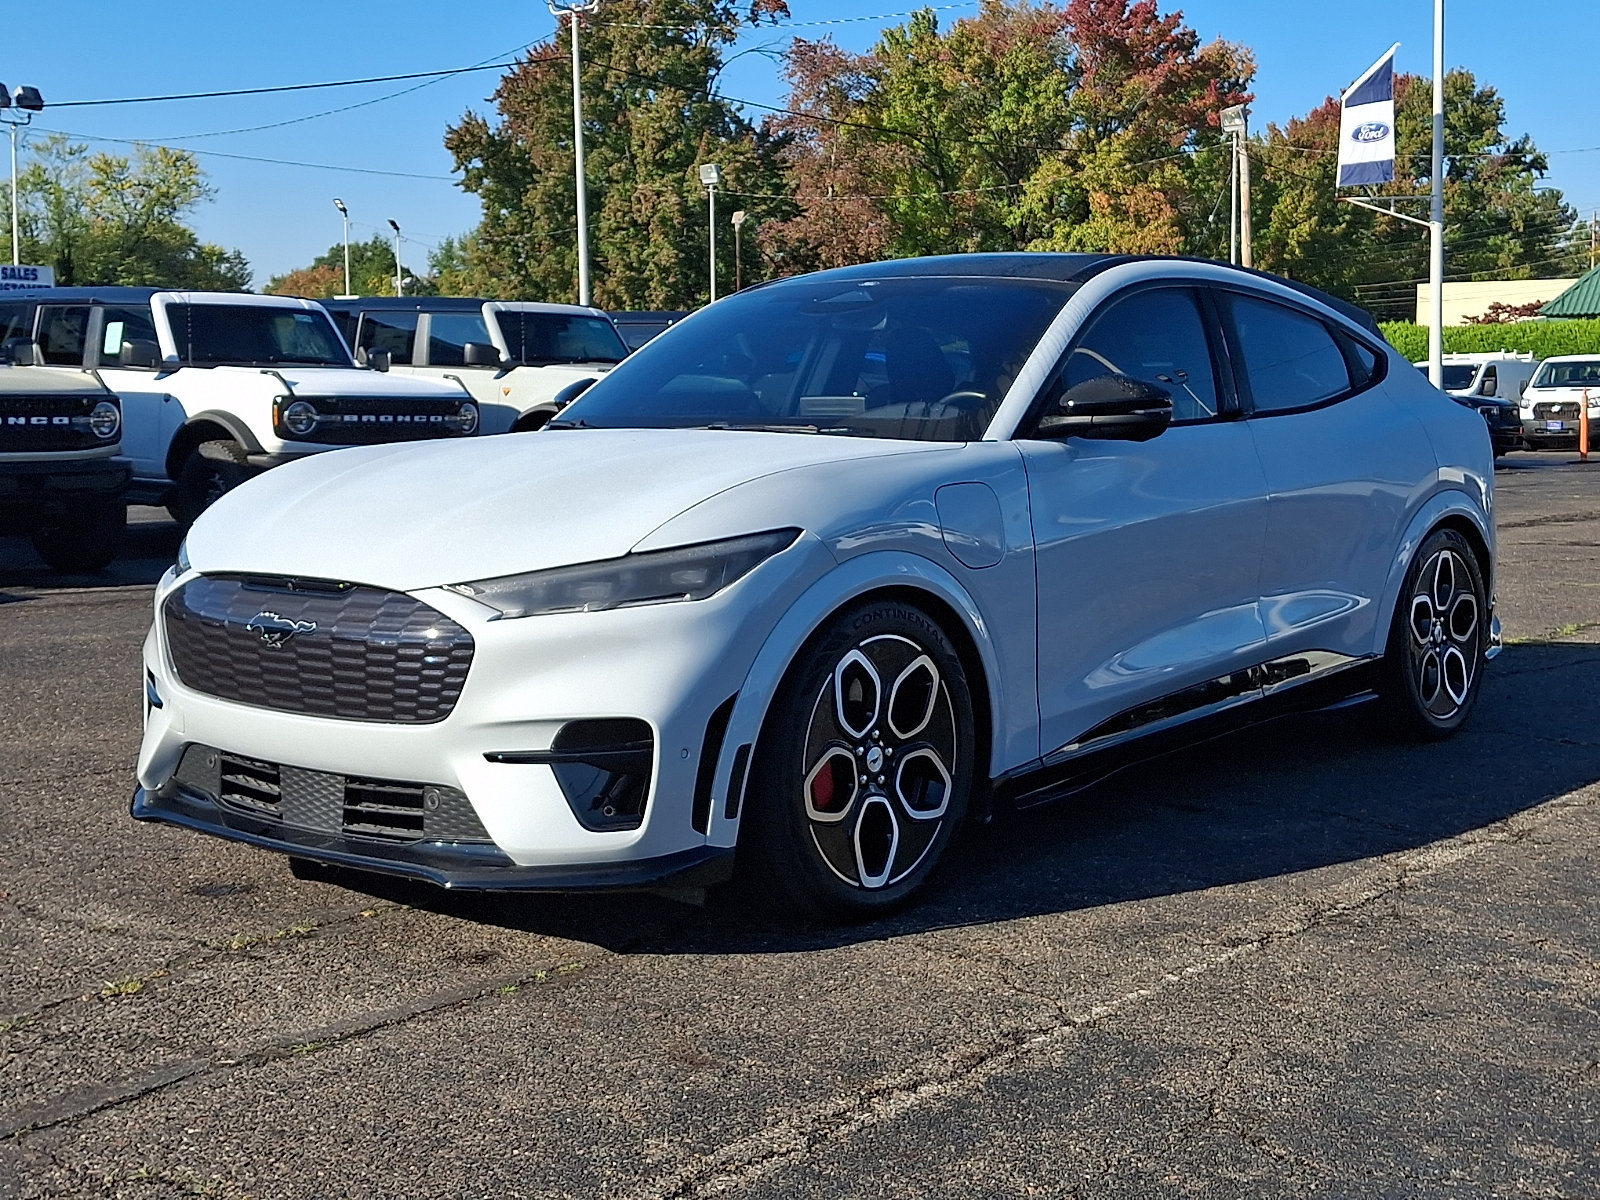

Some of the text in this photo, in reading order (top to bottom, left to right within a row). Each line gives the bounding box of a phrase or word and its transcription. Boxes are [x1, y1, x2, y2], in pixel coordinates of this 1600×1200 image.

[1358, 124, 1384, 140] Ford
[1, 266, 38, 280] SALES
[0, 416, 69, 425] NCO
[343, 415, 442, 423] BRONCO
[852, 608, 944, 648] CONTINENTAL
